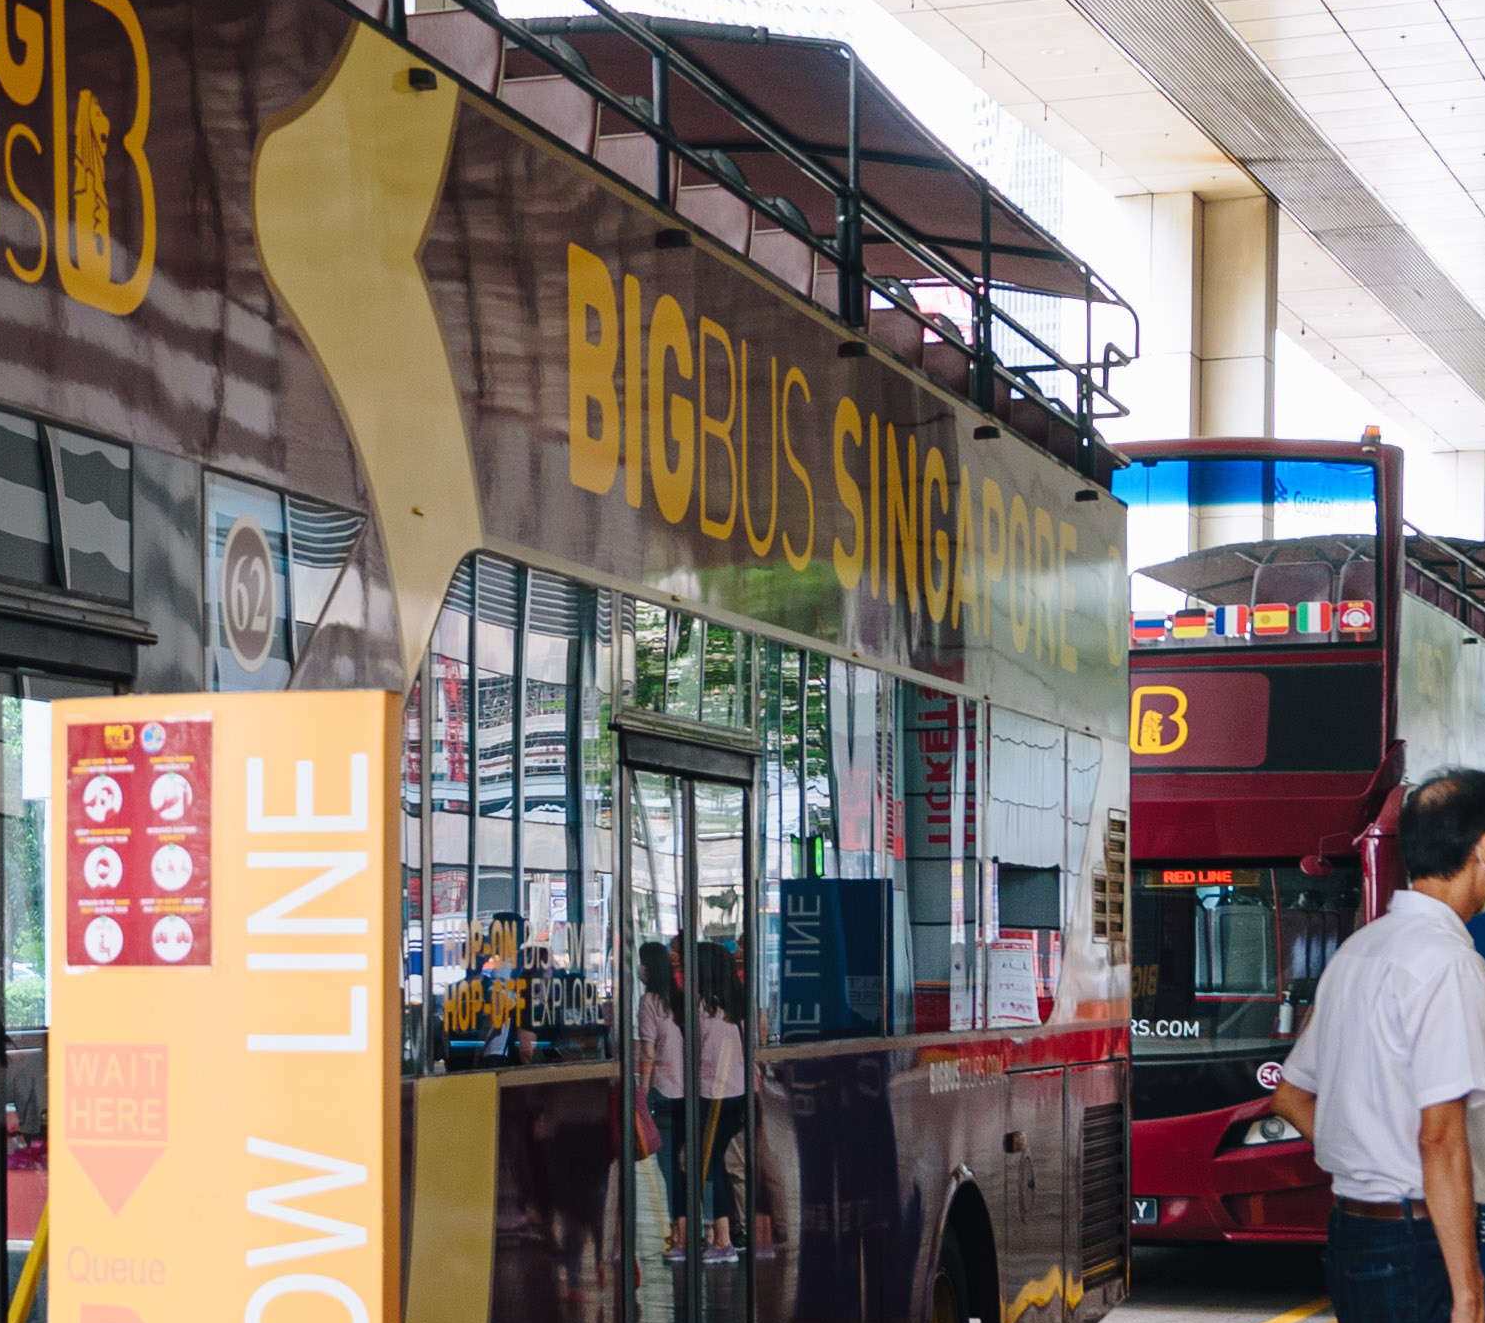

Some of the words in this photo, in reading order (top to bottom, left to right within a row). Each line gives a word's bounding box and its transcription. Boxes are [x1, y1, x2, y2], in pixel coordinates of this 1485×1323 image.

[832, 395, 1078, 673] SINGAPORE
[231, 554, 267, 632] 62
[246, 752, 369, 1053] LINE
[1162, 870, 1195, 884] RED
[1198, 870, 1233, 884] LINE
[443, 919, 518, 971] HOP-ON
[443, 978, 527, 1034] HOP-OFF
[530, 978, 606, 1027] EXPLORE
[69, 1051, 165, 1088] WAIT
[70, 1095, 163, 1136] HERE
[65, 1244, 167, 1288] Queue
